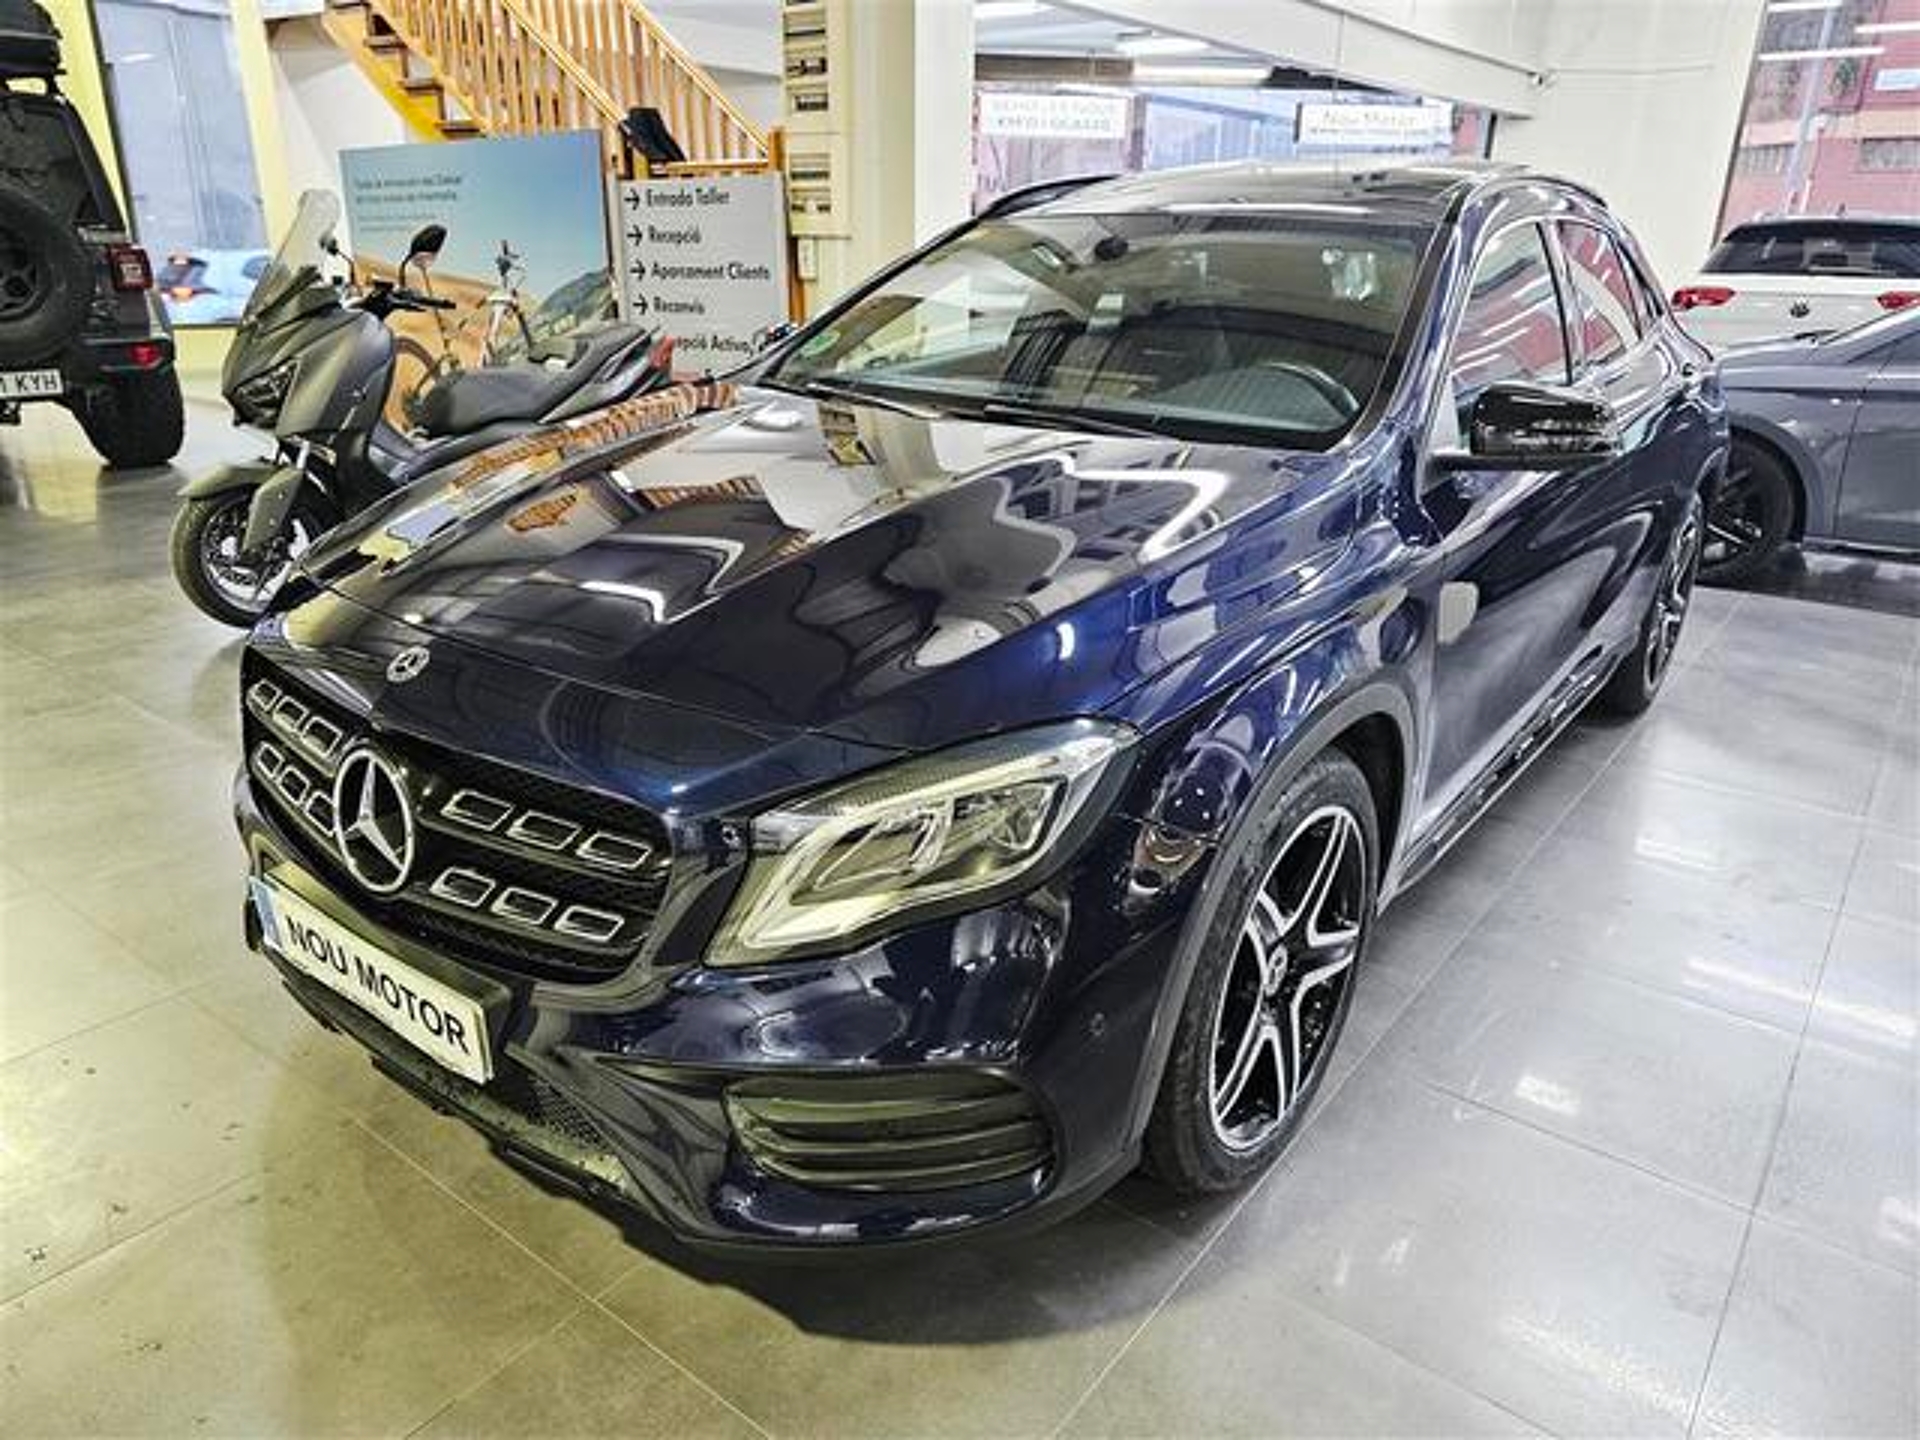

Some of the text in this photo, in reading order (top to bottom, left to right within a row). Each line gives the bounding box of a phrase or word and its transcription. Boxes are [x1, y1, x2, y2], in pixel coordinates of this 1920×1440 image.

[646, 187, 730, 207] Entrada Taller
[648, 225, 701, 245] Recepció
[651, 260, 770, 280] Aparcament Clients
[653, 296, 705, 315] Recanvis
[15, 373, 58, 393] KYH
[286, 915, 471, 1054] NOU MOTOR
